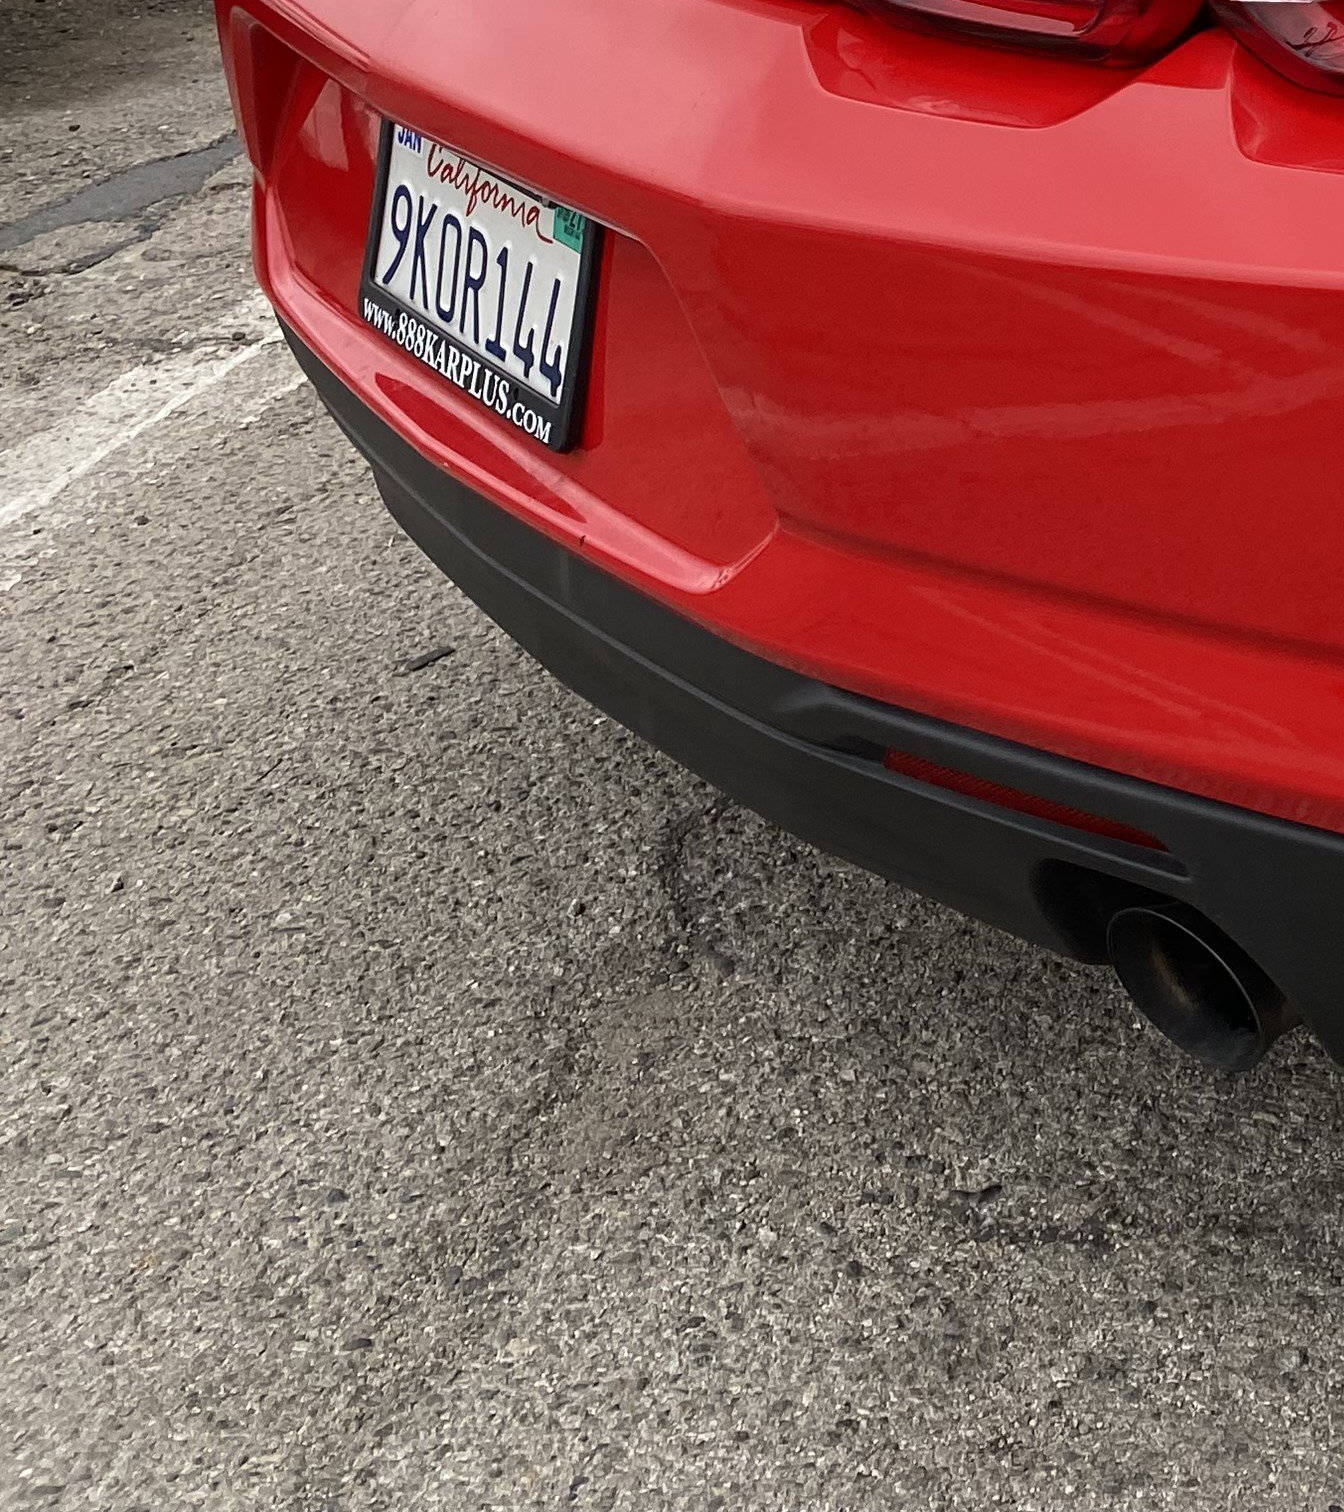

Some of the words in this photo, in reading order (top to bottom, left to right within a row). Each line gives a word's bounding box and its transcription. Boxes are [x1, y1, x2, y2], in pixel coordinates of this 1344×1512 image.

[398, 127, 422, 154] JAN
[427, 143, 554, 244] California
[382, 184, 562, 397] 9KOR144
